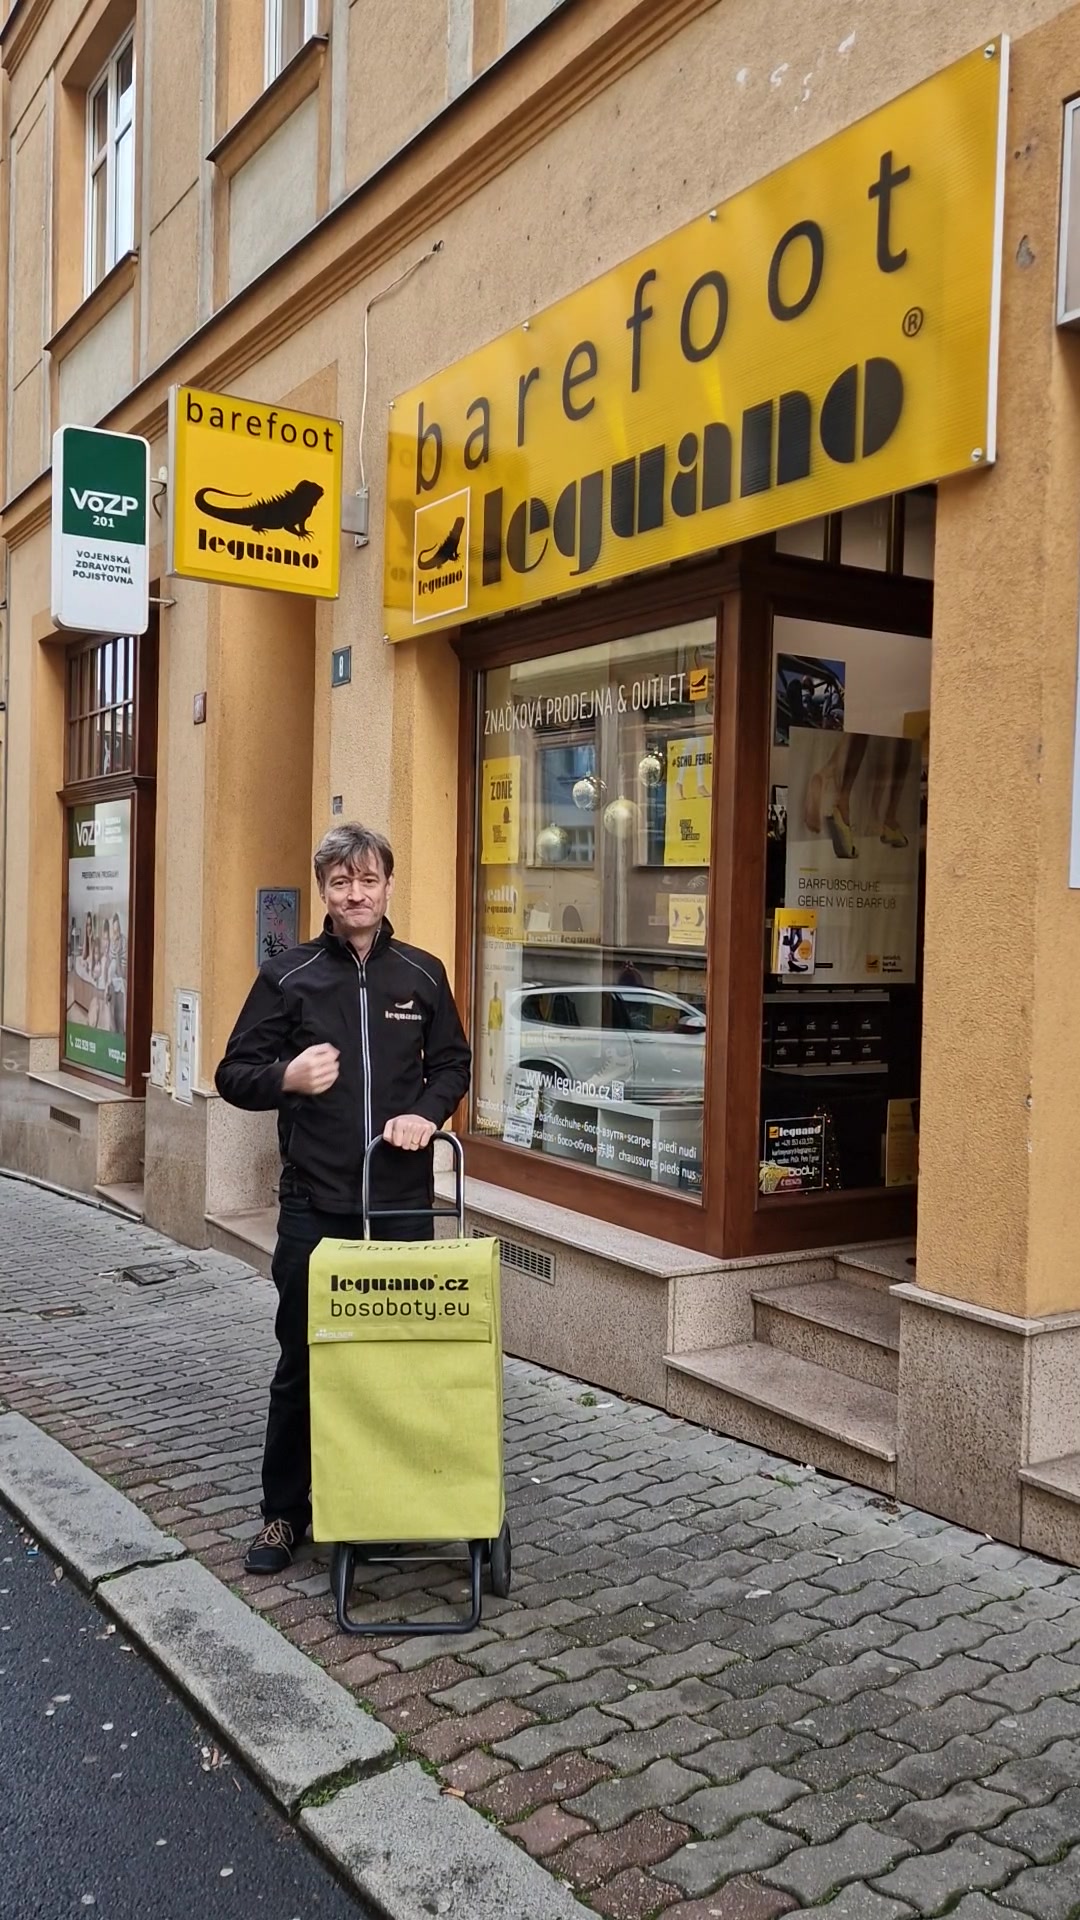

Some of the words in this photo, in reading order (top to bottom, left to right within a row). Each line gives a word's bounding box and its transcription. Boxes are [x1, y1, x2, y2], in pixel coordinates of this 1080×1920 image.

[416, 150, 911, 495] barefoot
[186, 393, 333, 452] barefoot
[482, 356, 904, 586] leguano
[69, 487, 138, 517] VoZP
[92, 515, 115, 528] 201
[76, 550, 130, 564] VOJENSKÁ
[198, 528, 319, 569] leguano
[75, 560, 131, 574] ZDRAVOTNÍ
[418, 570, 462, 596] leguano
[484, 696, 543, 736] ZNAČKOVÁ
[546, 688, 613, 725] PRODEJNA
[618, 685, 627, 713] &
[632, 672, 686, 709] OUTLET
[491, 780, 512, 800] ZONE
[798, 895, 833, 907] GEHEN
[836, 896, 853, 908] WIE
[385, 1010, 422, 1021] leguano
[526, 1070, 610, 1100] www.leguano.cz
[627, 1133, 650, 1148] scarpe
[659, 1140, 677, 1154] piedi
[679, 1146, 697, 1158] nudi
[619, 1150, 657, 1170] chaussures
[660, 1161, 679, 1176] pieds
[682, 1168, 696, 1180] nus
[331, 1297, 470, 1321] bosoboty.eu
